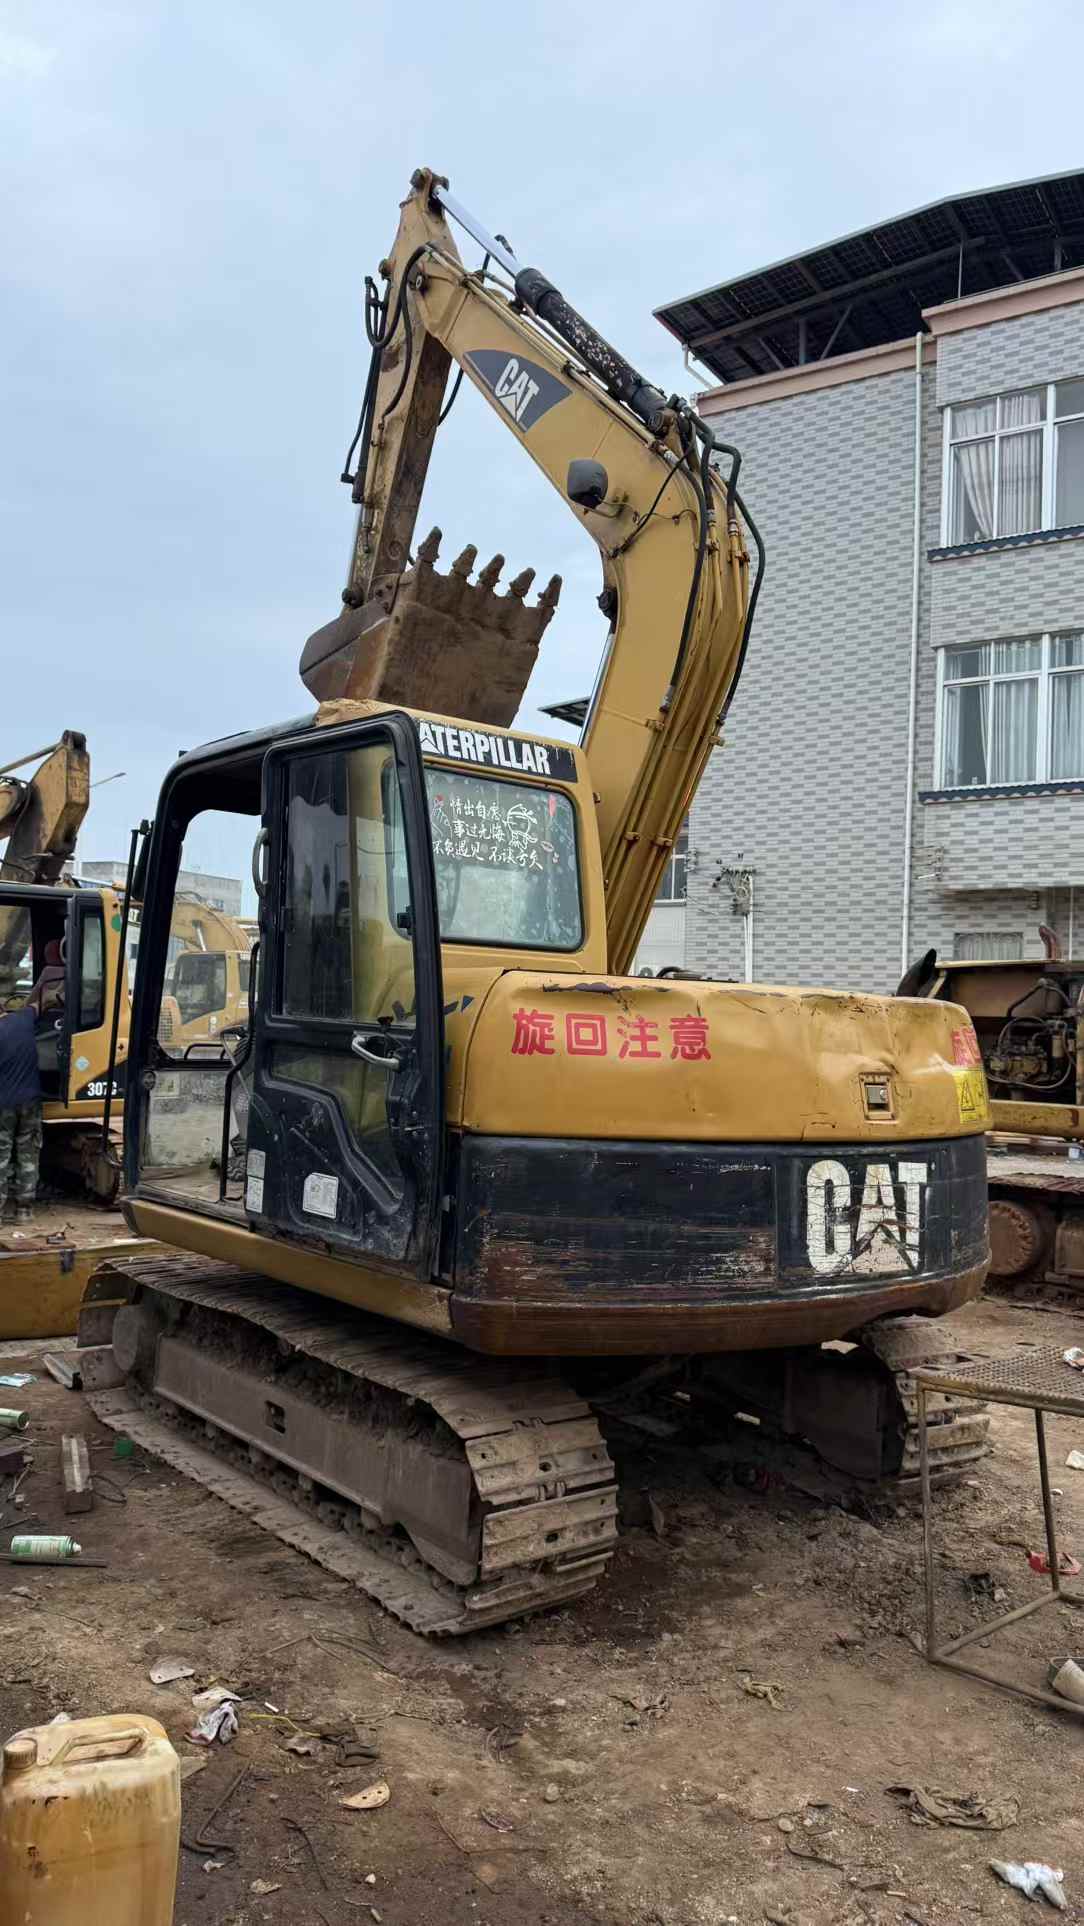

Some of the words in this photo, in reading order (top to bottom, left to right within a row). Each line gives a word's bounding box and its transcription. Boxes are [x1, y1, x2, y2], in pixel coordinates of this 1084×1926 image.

[495, 358, 540, 422] CAT
[420, 721, 552, 775] ATERPILLAR
[511, 1007, 712, 1061] 旋回注意
[806, 1159, 928, 1274] CAT
